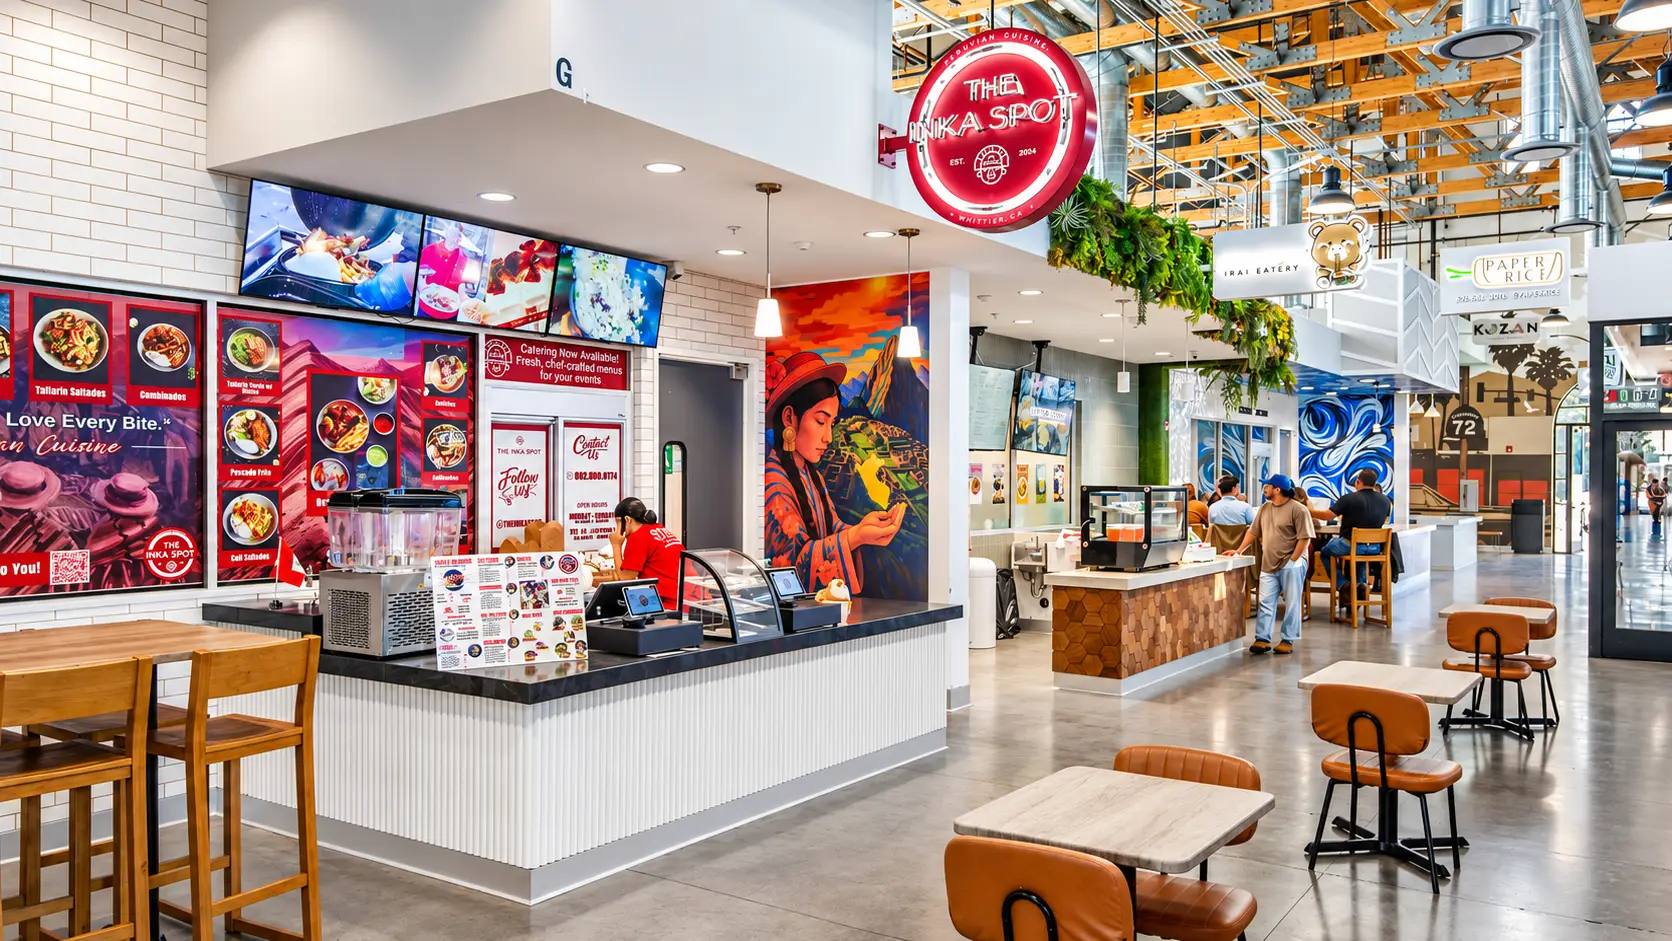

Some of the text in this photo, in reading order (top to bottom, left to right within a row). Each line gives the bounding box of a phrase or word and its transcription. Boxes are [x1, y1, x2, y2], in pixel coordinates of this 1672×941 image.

[556, 57, 572, 89] G
[963, 73, 1024, 101] THE
[909, 92, 1079, 144] INKA SPOT
[949, 157, 965, 166] EST.
[1010, 211, 1023, 220] CA
[1224, 264, 1299, 277] IRAI EATERY
[1486, 256, 1544, 271] PAPER
[1505, 268, 1546, 282] RICE
[1474, 322, 1538, 336] KOZAN
[520, 344, 619, 364] Catering Now Available!
[516, 356, 623, 375] Fresh, chef-crafted menus
[540, 370, 602, 385] for your events
[35, 386, 106, 398] Tallarin Saltados
[140, 391, 187, 401] Combinados
[6, 412, 56, 428] Love
[62, 414, 117, 433] Every
[1452, 420, 1476, 435] 72
[37, 434, 121, 455] Cuisine
[573, 434, 610, 455] Contact
[588, 449, 600, 460] Us
[498, 467, 539, 490] Follow
[164, 541, 180, 549] THE
[146, 549, 195, 559] INKA SPOT
[13, 562, 40, 575] You!
